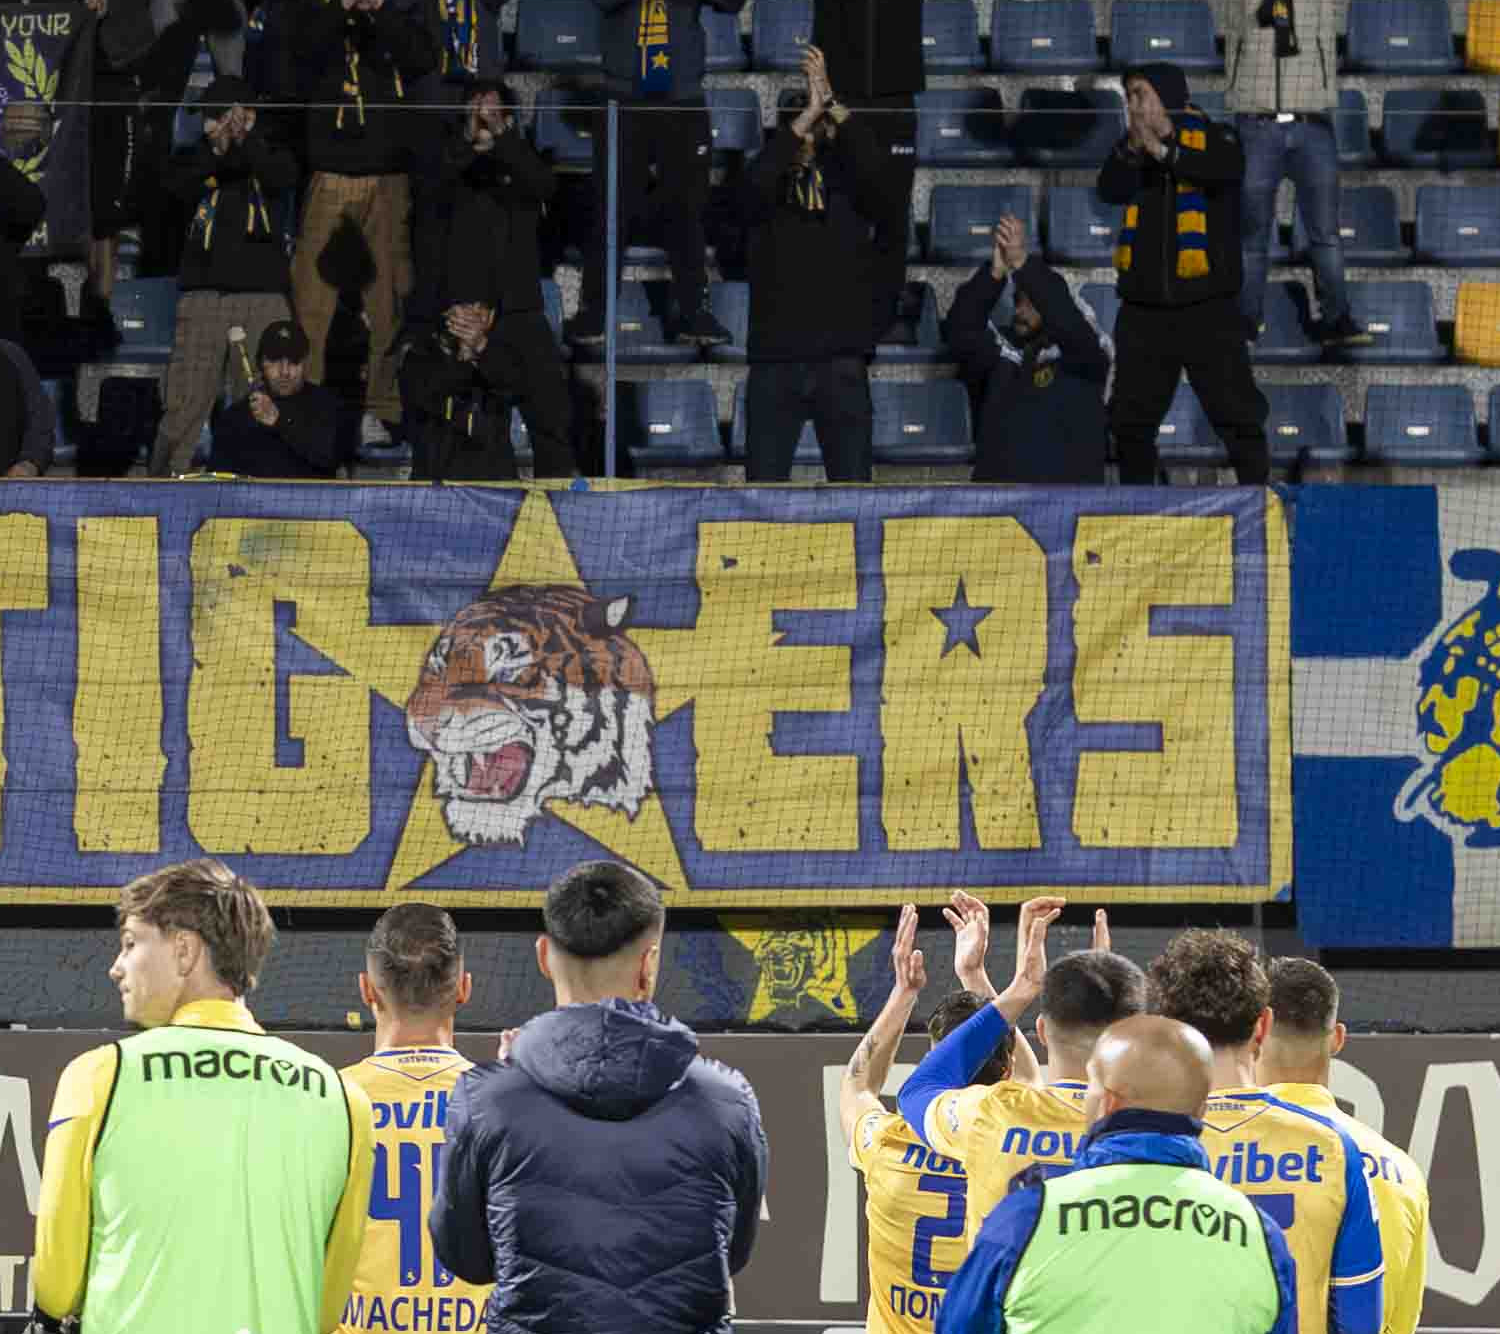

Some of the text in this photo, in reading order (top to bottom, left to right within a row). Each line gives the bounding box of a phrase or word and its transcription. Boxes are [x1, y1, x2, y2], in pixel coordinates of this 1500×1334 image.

[0, 12, 72, 37] YOUR
[142, 1048, 327, 1099] macron
[1214, 1141, 1325, 1185] vibet
[1058, 1194, 1249, 1248] macron
